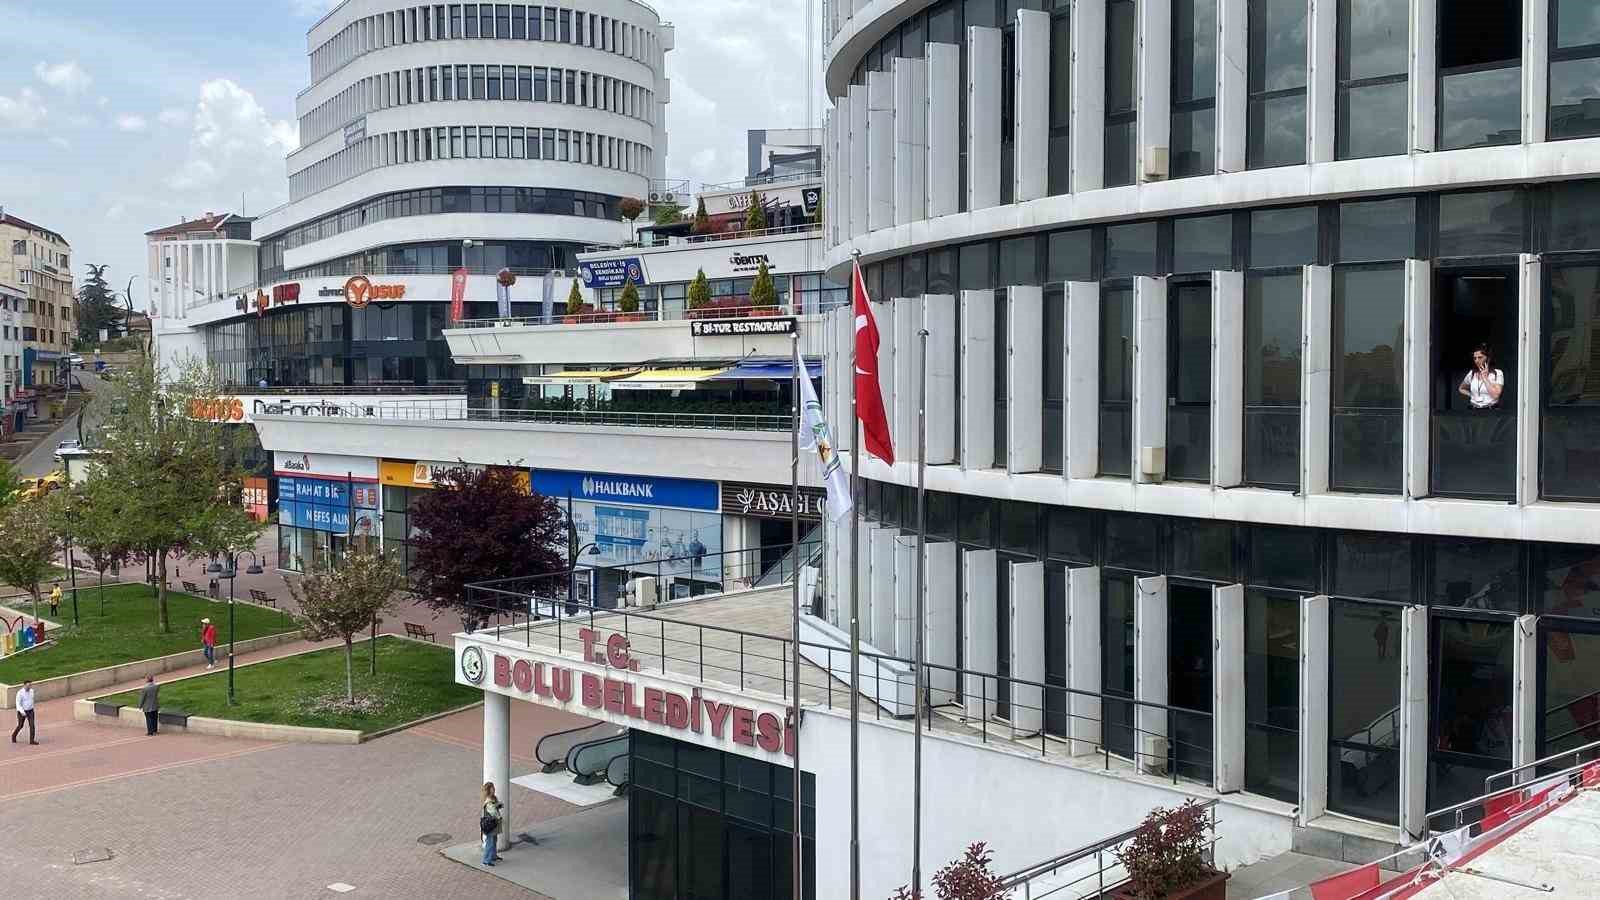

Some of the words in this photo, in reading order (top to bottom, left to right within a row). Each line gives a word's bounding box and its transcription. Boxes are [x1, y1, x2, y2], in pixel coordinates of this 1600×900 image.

[733, 321, 792, 333] RESTAURANT
[296, 484, 322, 497] RAHAT
[325, 484, 339, 499] BİR
[595, 480, 654, 498] HALKBANK
[756, 491, 810, 516] AŞAĞI
[306, 510, 330, 523] NEFES
[332, 512, 350, 525] ALIN
[578, 628, 640, 673] T.C.
[494, 654, 574, 703] BOLU
[582, 672, 795, 757] BELEDİYESİ
